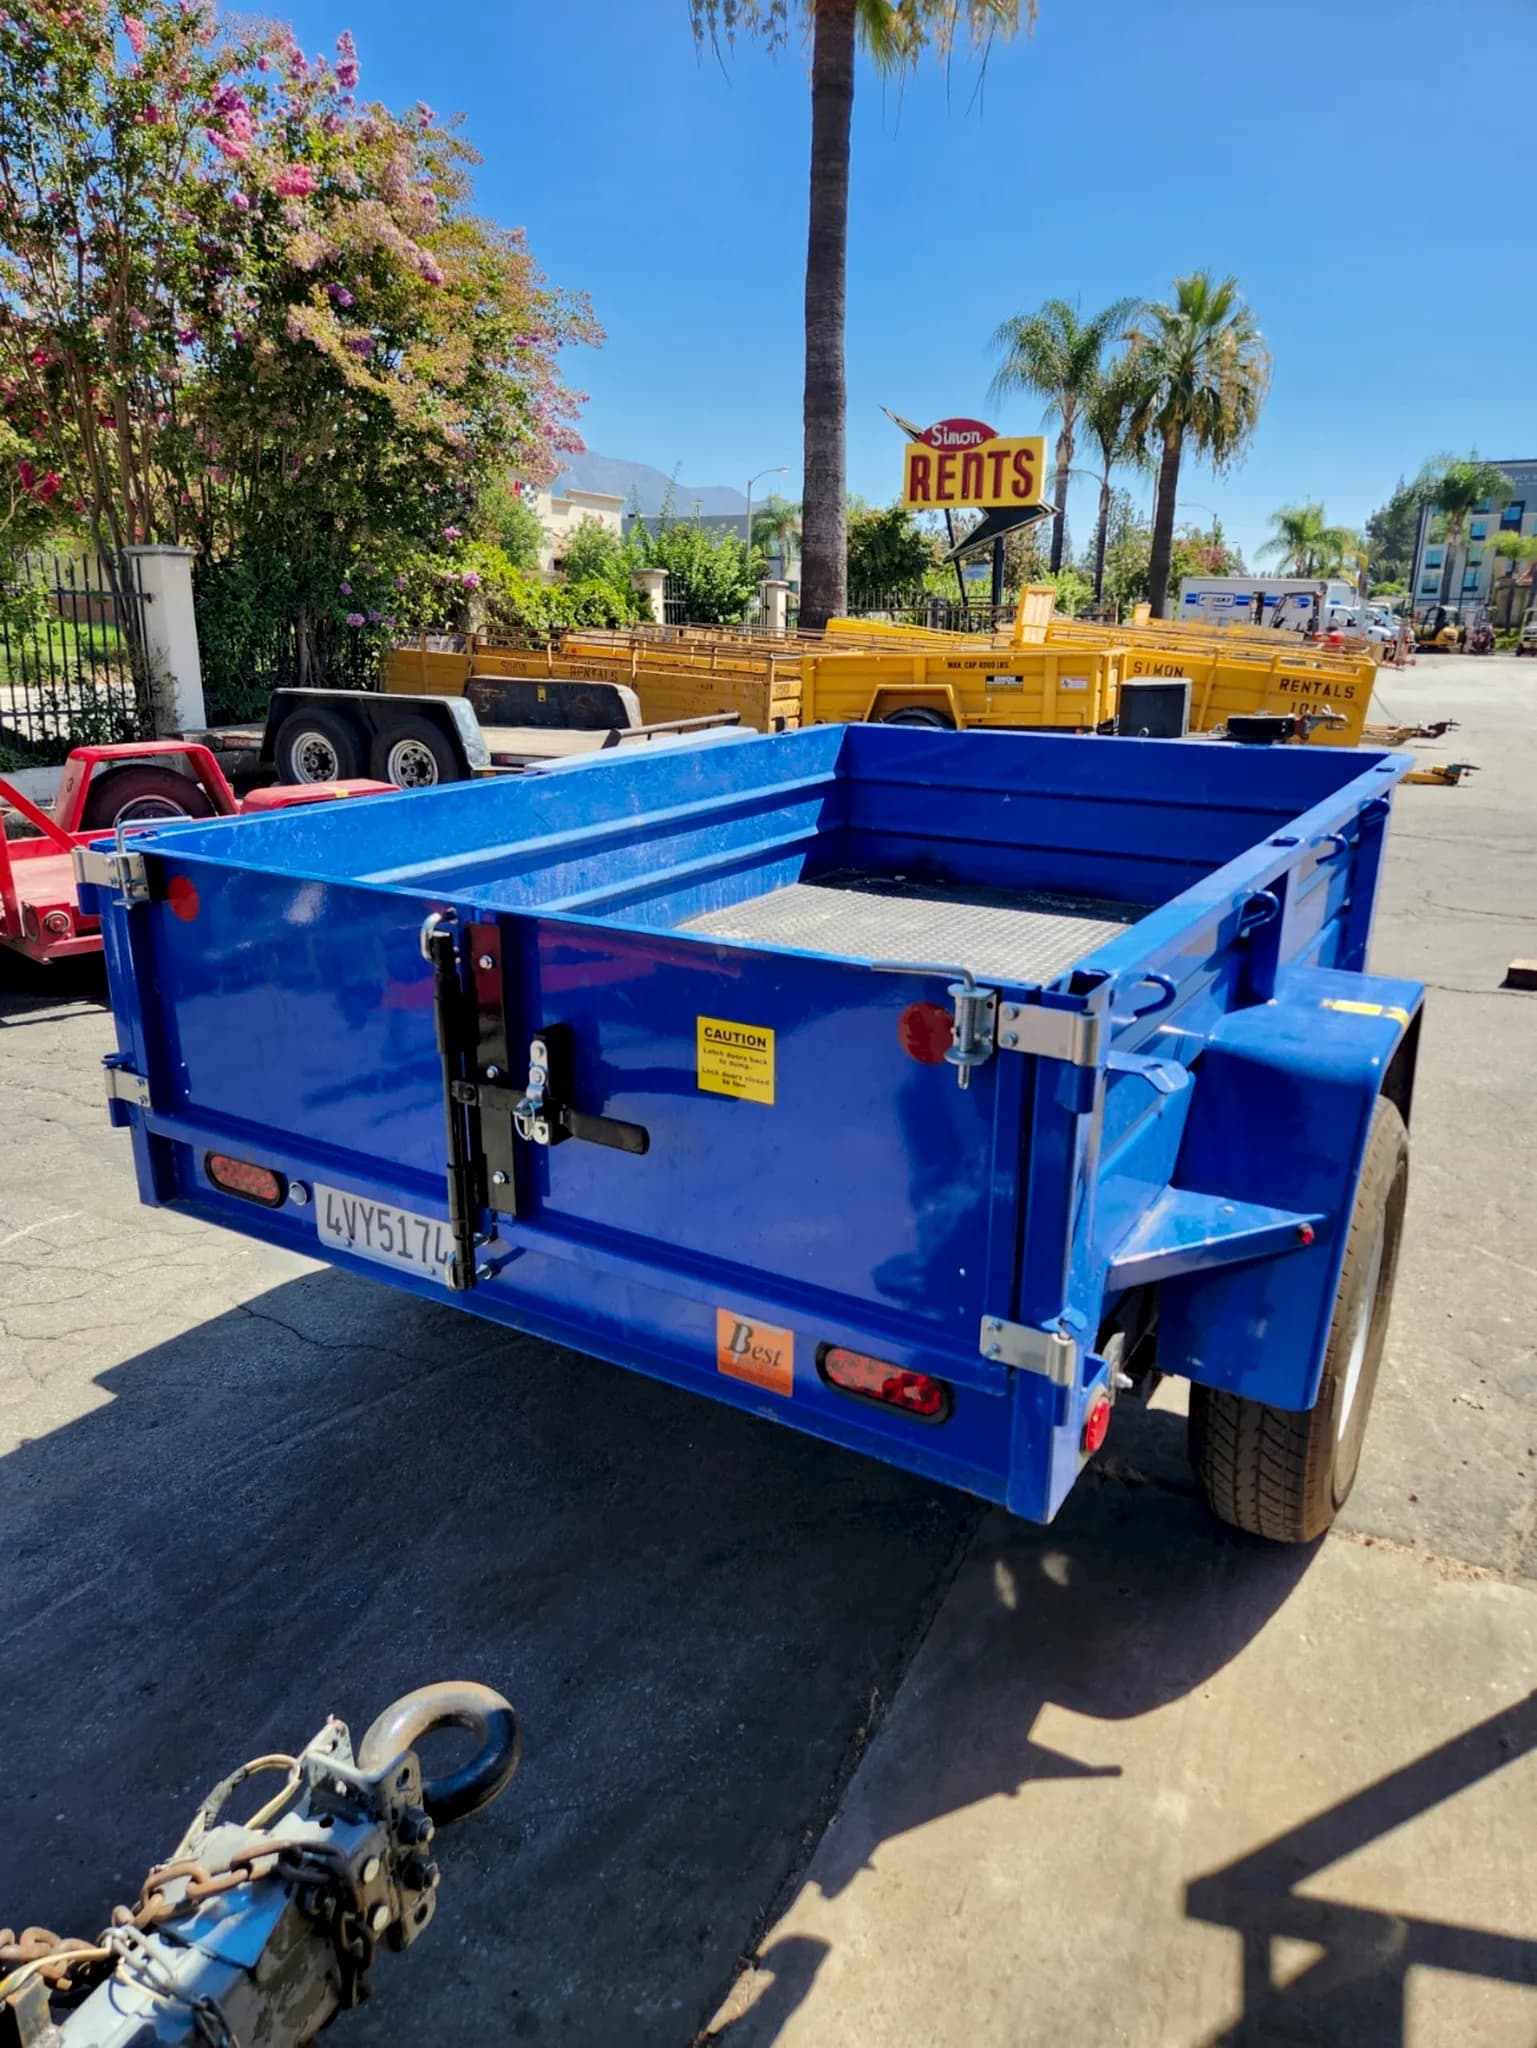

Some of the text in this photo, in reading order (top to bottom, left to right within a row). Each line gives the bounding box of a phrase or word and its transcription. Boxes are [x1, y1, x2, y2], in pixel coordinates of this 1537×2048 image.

[931, 424, 983, 447] Simon
[909, 449, 1034, 502] RENTS
[1133, 660, 1184, 678] SIMON
[1279, 678, 1355, 699] RENTALS
[704, 1027, 767, 1048] CAUTION
[725, 1320, 782, 1367] Best
